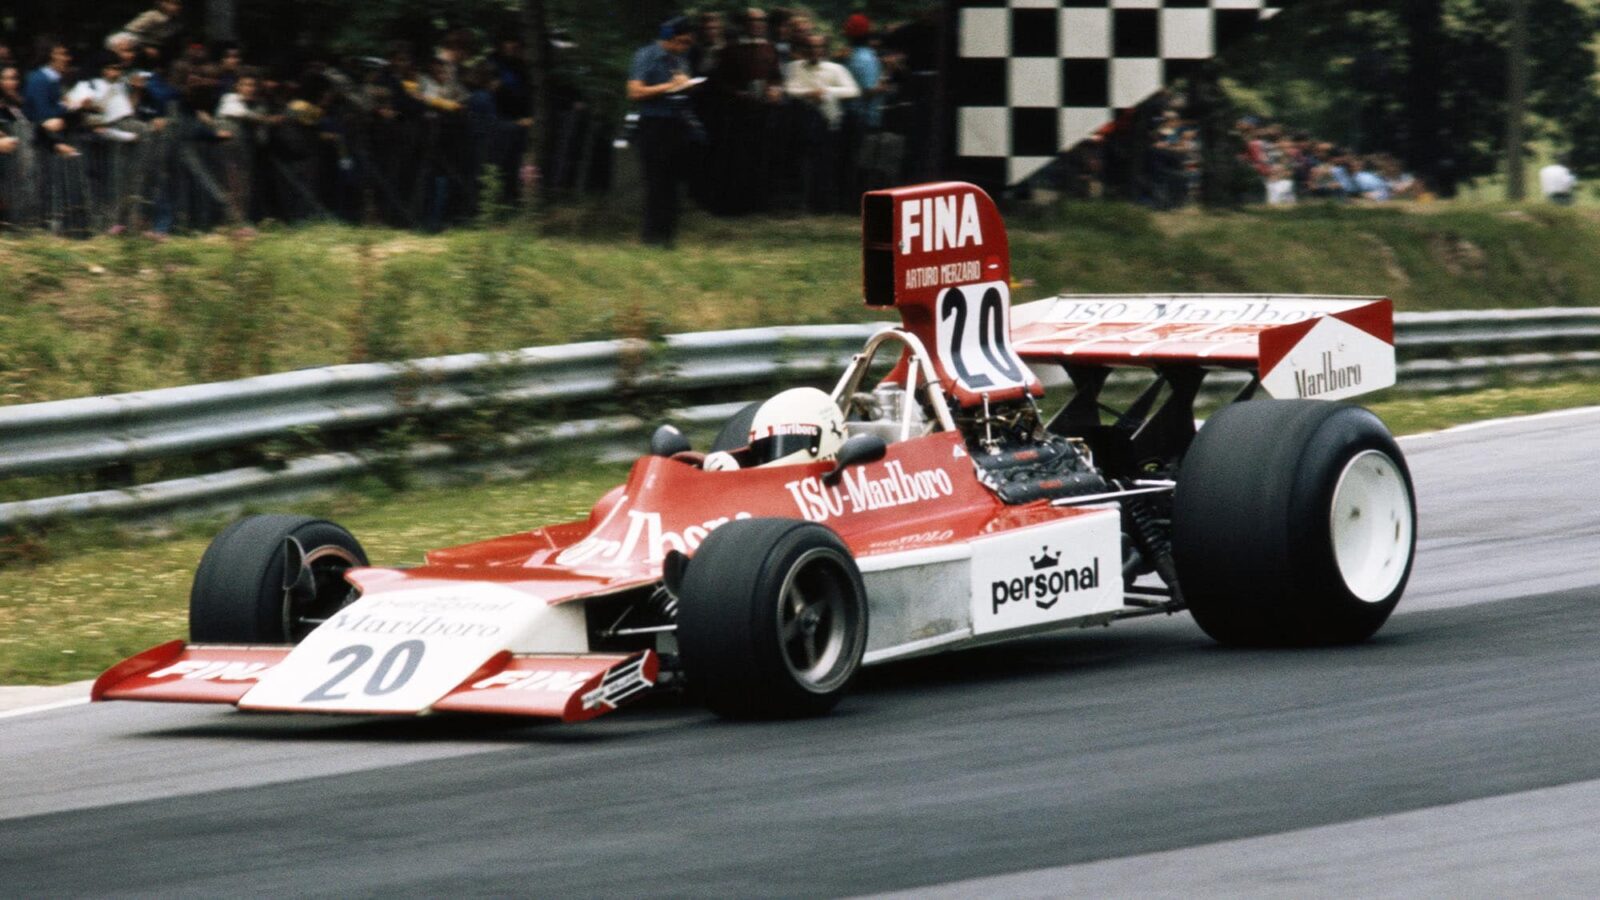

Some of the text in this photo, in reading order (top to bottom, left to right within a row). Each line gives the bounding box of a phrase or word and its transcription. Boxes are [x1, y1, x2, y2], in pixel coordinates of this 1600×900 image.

[902, 193, 983, 255] FINA
[905, 260, 981, 290] ARTURO MERZARIO
[942, 287, 1024, 389] 20
[1064, 303, 1328, 322] ISO-Marlbor
[1294, 351, 1362, 398] Marlboro
[785, 460, 953, 522] ISO-Marlboro
[992, 557, 1099, 615] personal
[335, 614, 501, 637] Marlboro
[147, 660, 269, 680] FIN
[299, 639, 426, 703] 20
